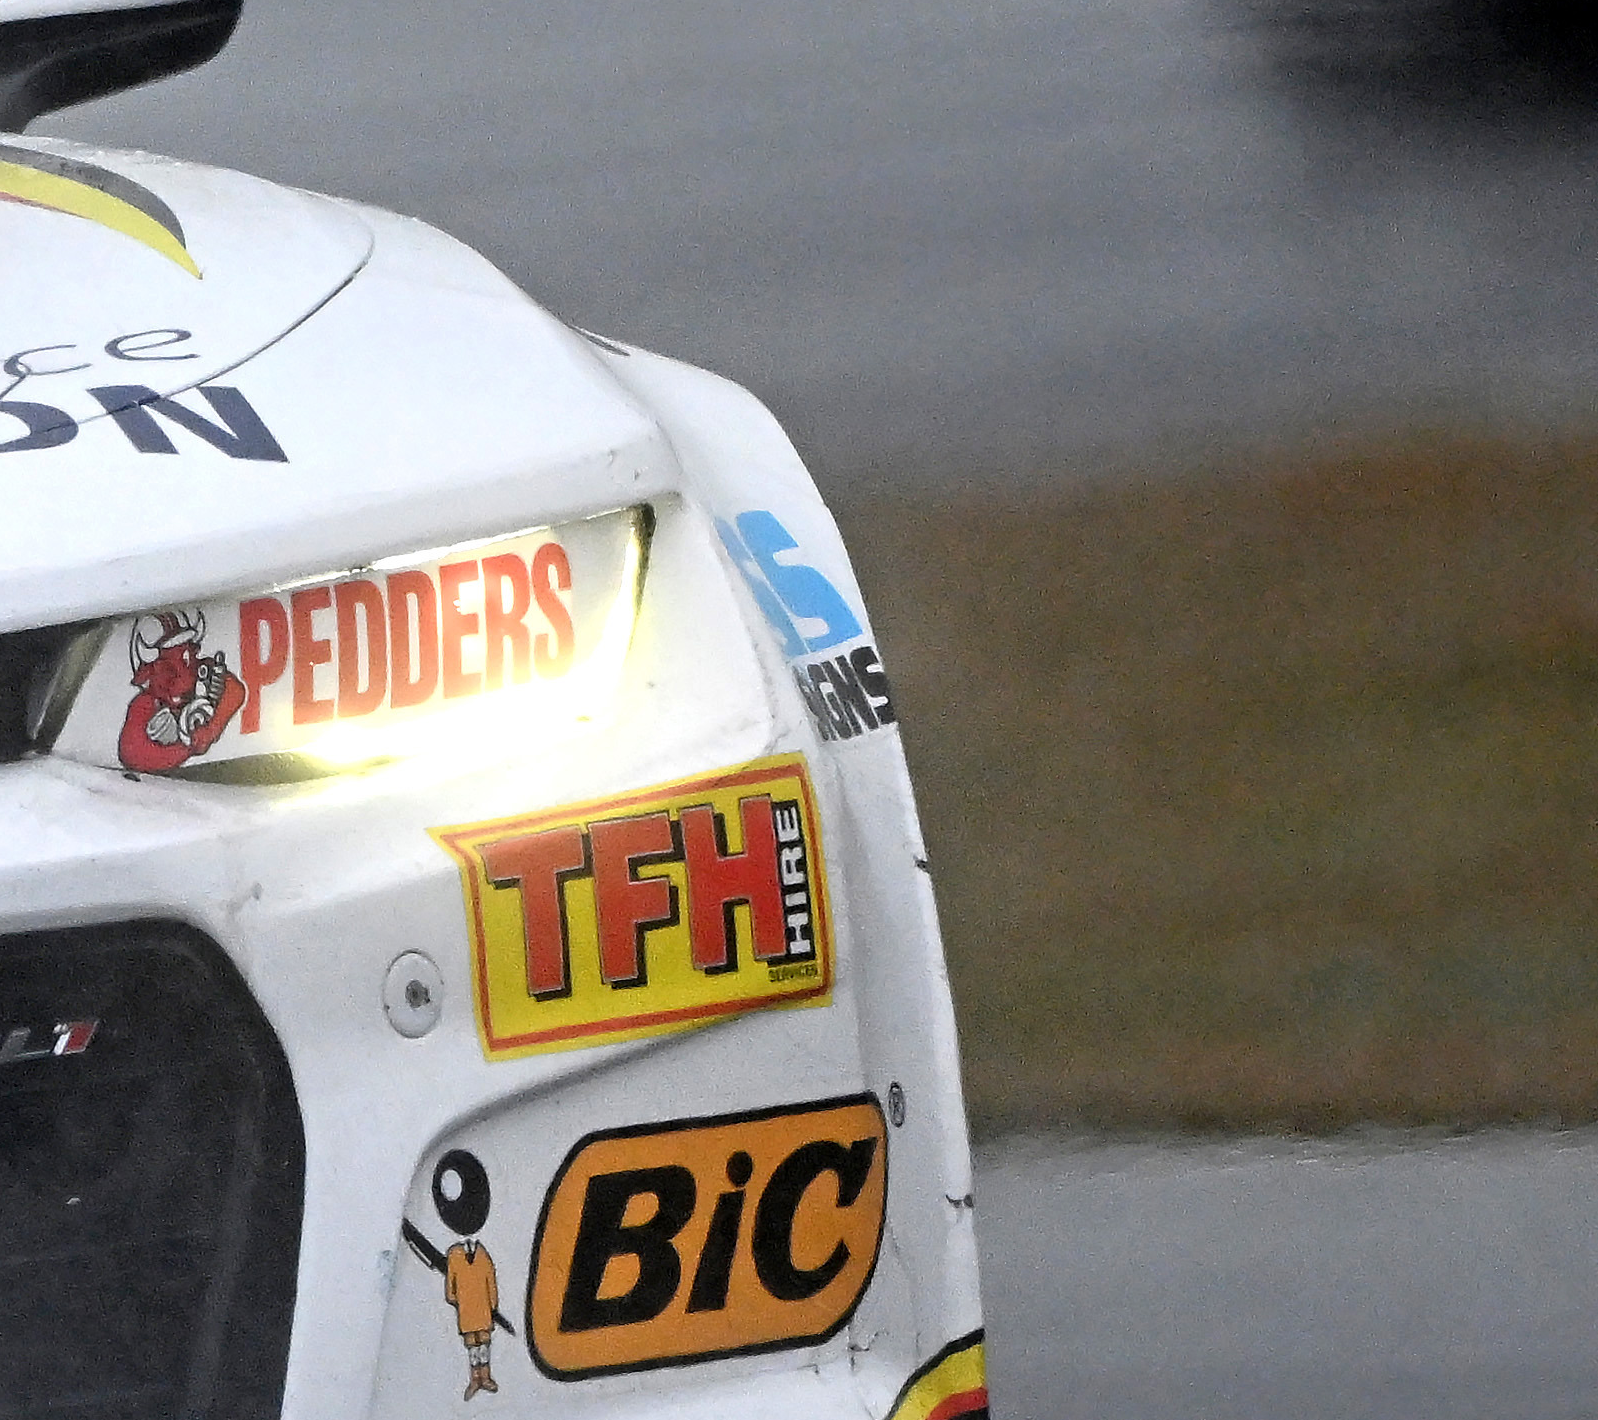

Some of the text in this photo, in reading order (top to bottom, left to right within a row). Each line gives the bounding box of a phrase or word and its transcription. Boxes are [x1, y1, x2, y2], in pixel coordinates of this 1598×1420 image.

[238, 542, 576, 735] PEDDERS
[478, 794, 811, 1003] TFH HIRE
